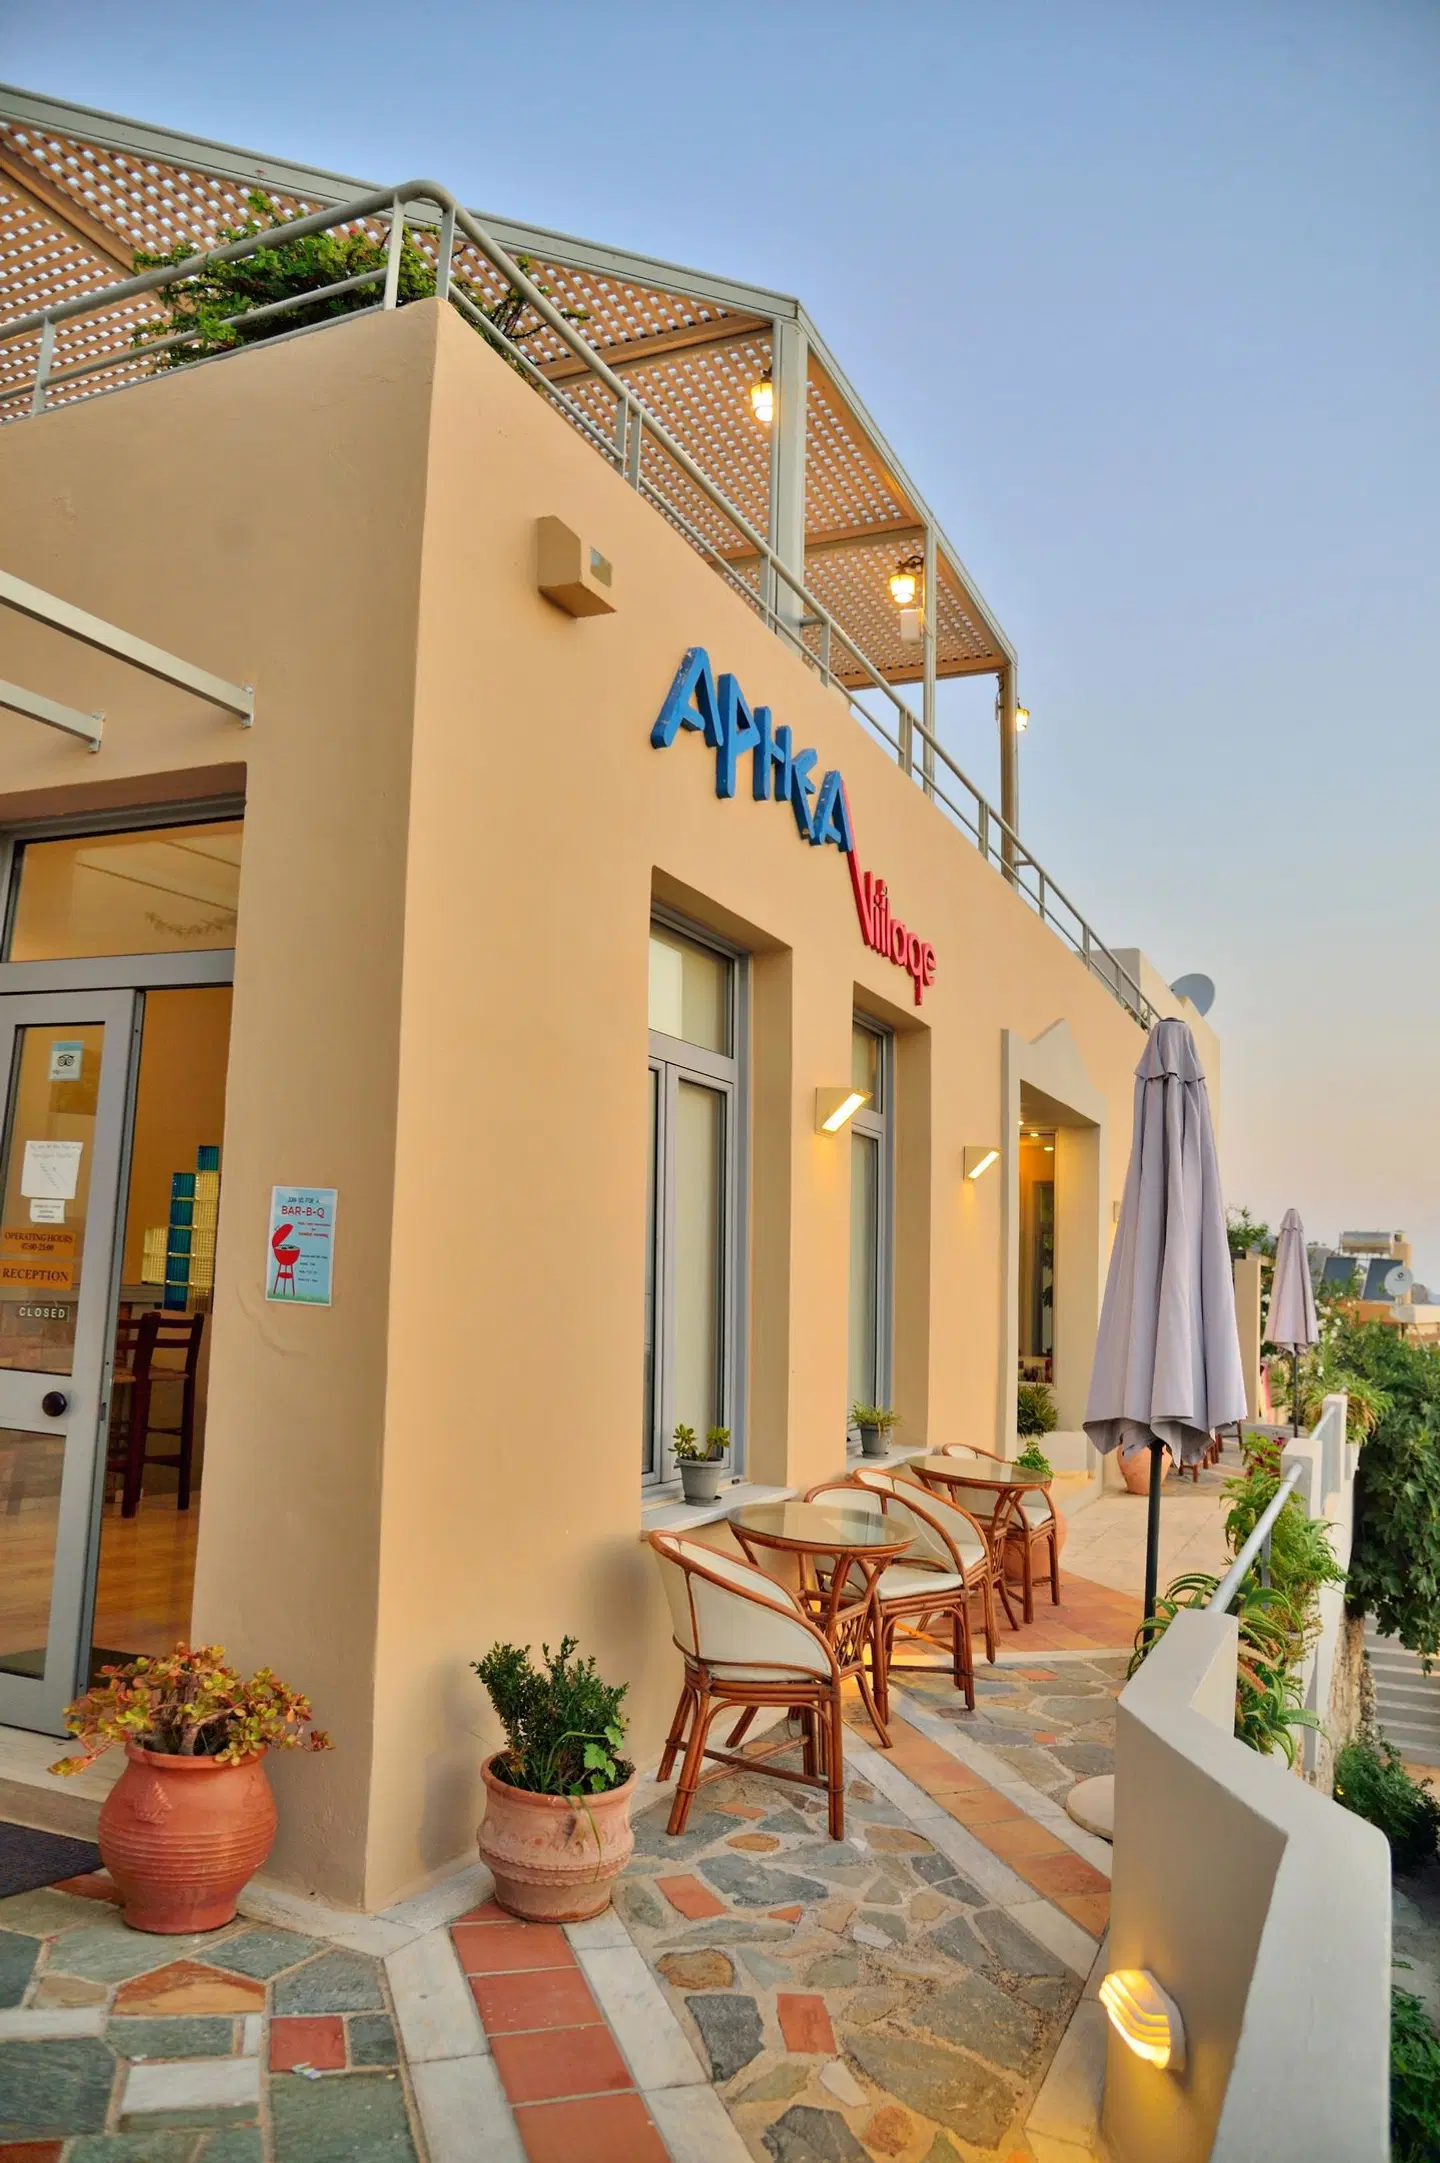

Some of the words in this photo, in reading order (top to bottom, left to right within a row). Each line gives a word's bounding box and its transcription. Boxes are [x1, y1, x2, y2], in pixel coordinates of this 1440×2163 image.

[844, 776, 937, 1006] Village
[281, 1205, 325, 1219] BAR-B-Q
[3, 1268, 69, 1282] RECEPTION
[19, 1307, 65, 1318] CLOSED
